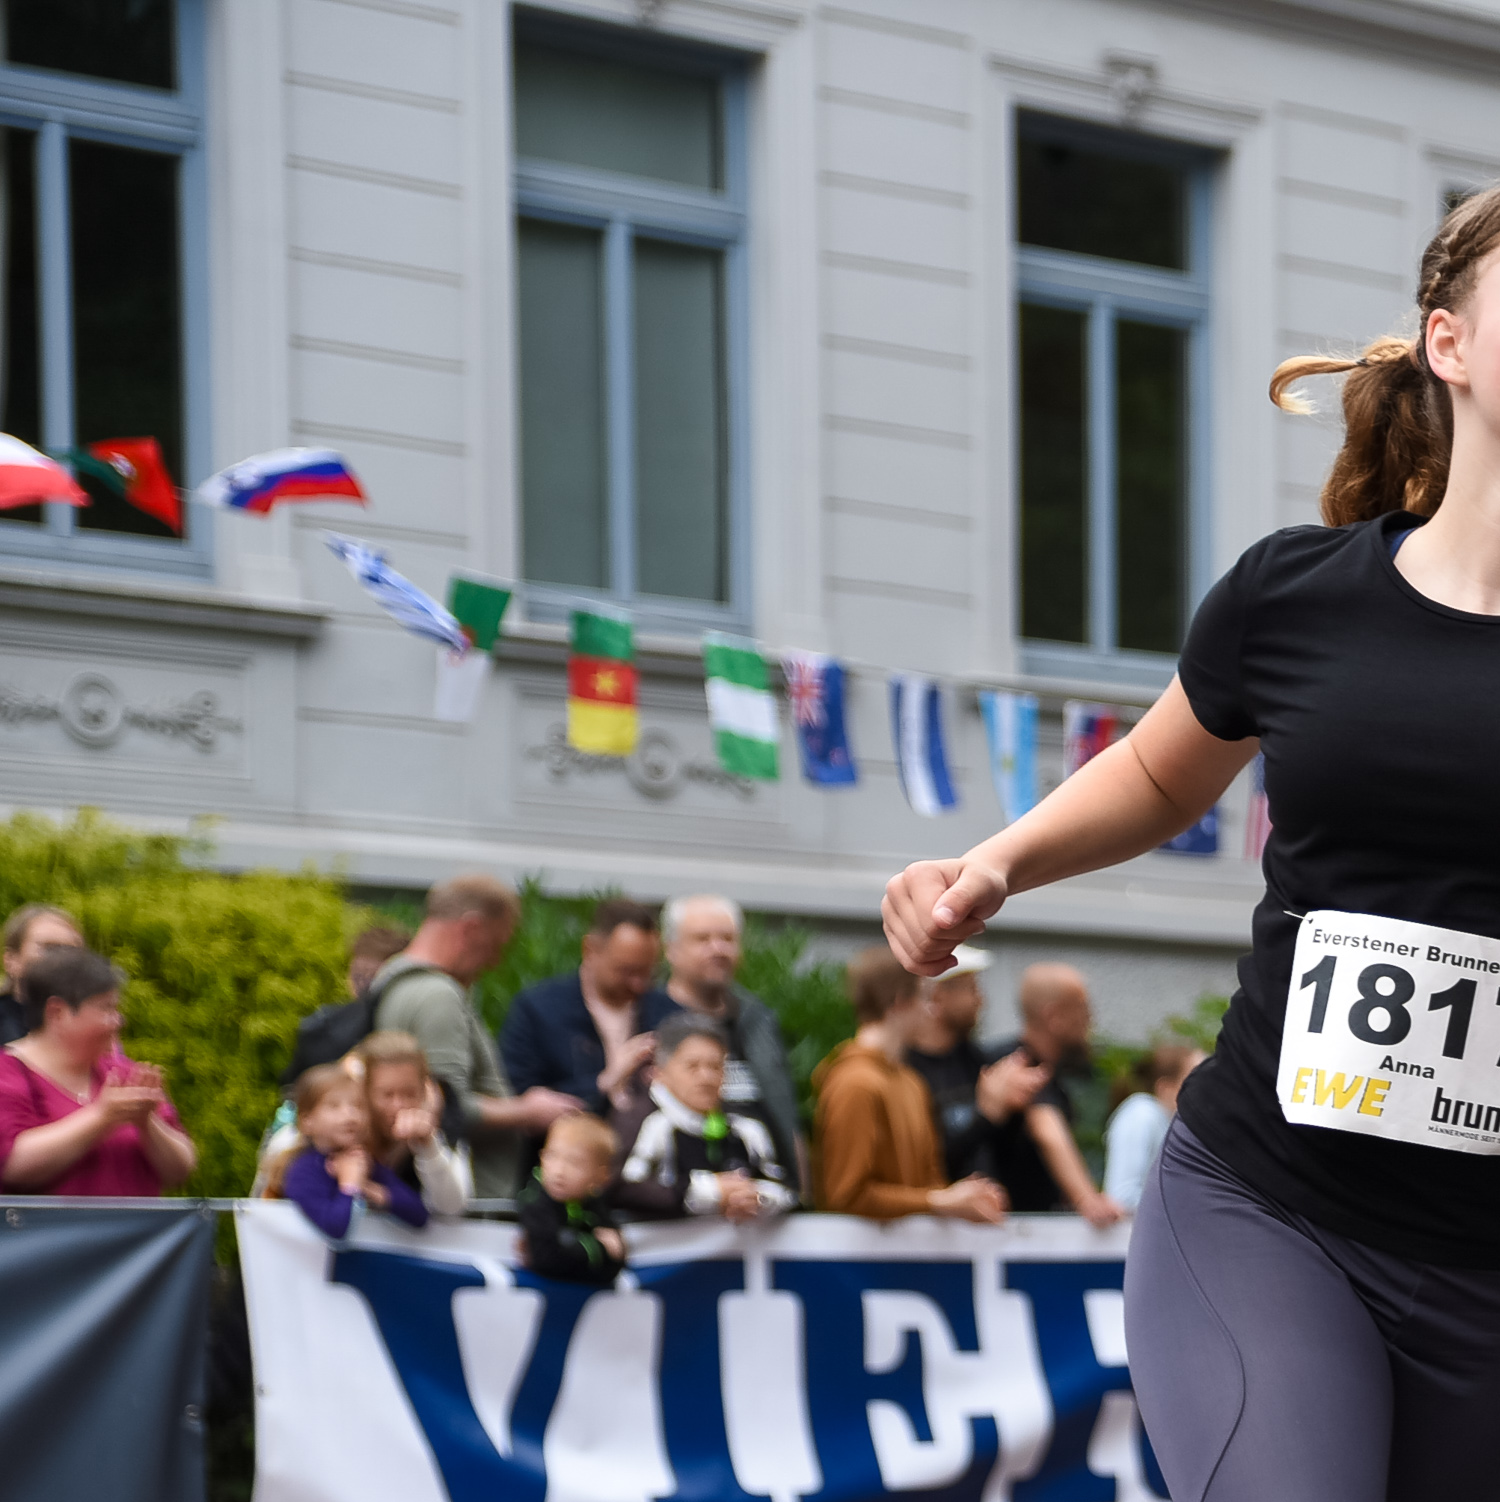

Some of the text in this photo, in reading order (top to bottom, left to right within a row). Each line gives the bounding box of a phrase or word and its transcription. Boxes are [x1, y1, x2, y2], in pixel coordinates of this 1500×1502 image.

[1312, 928, 1420, 958] Everstener
[1378, 1055, 1435, 1080] Anna
[1290, 1066, 1392, 1117] EWE
